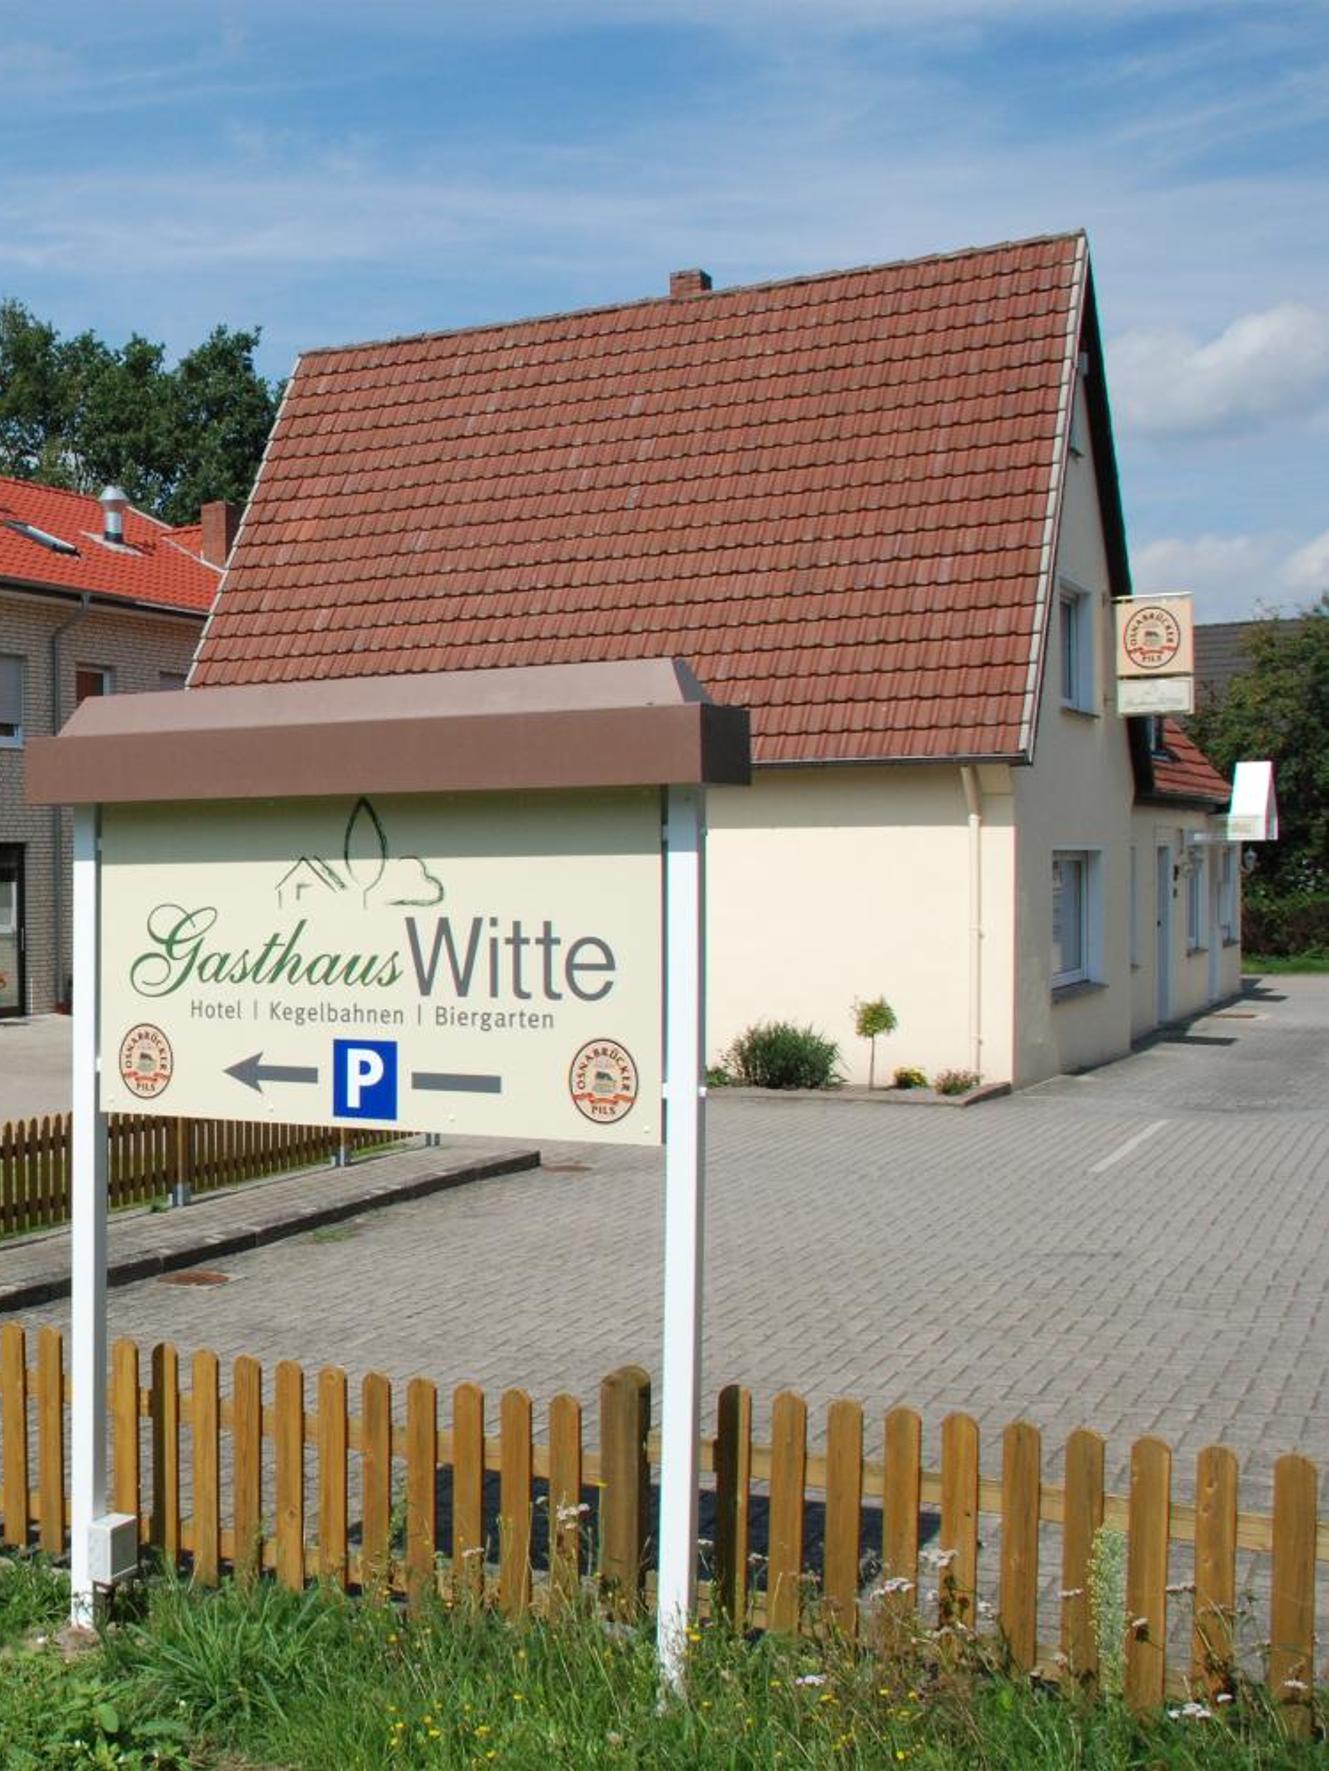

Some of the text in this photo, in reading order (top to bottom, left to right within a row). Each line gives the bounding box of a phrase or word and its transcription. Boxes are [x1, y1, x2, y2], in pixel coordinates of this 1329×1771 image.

[130, 903, 616, 1001] Gasthaus Witte
[191, 1000, 555, 1032] Hotel Kegelbahnen Biergarten
[135, 1082, 156, 1092] PILS
[347, 1047, 385, 1109] P
[576, 1047, 630, 1092] OSNABRÜCKER
[591, 1105, 616, 1116] PILS
